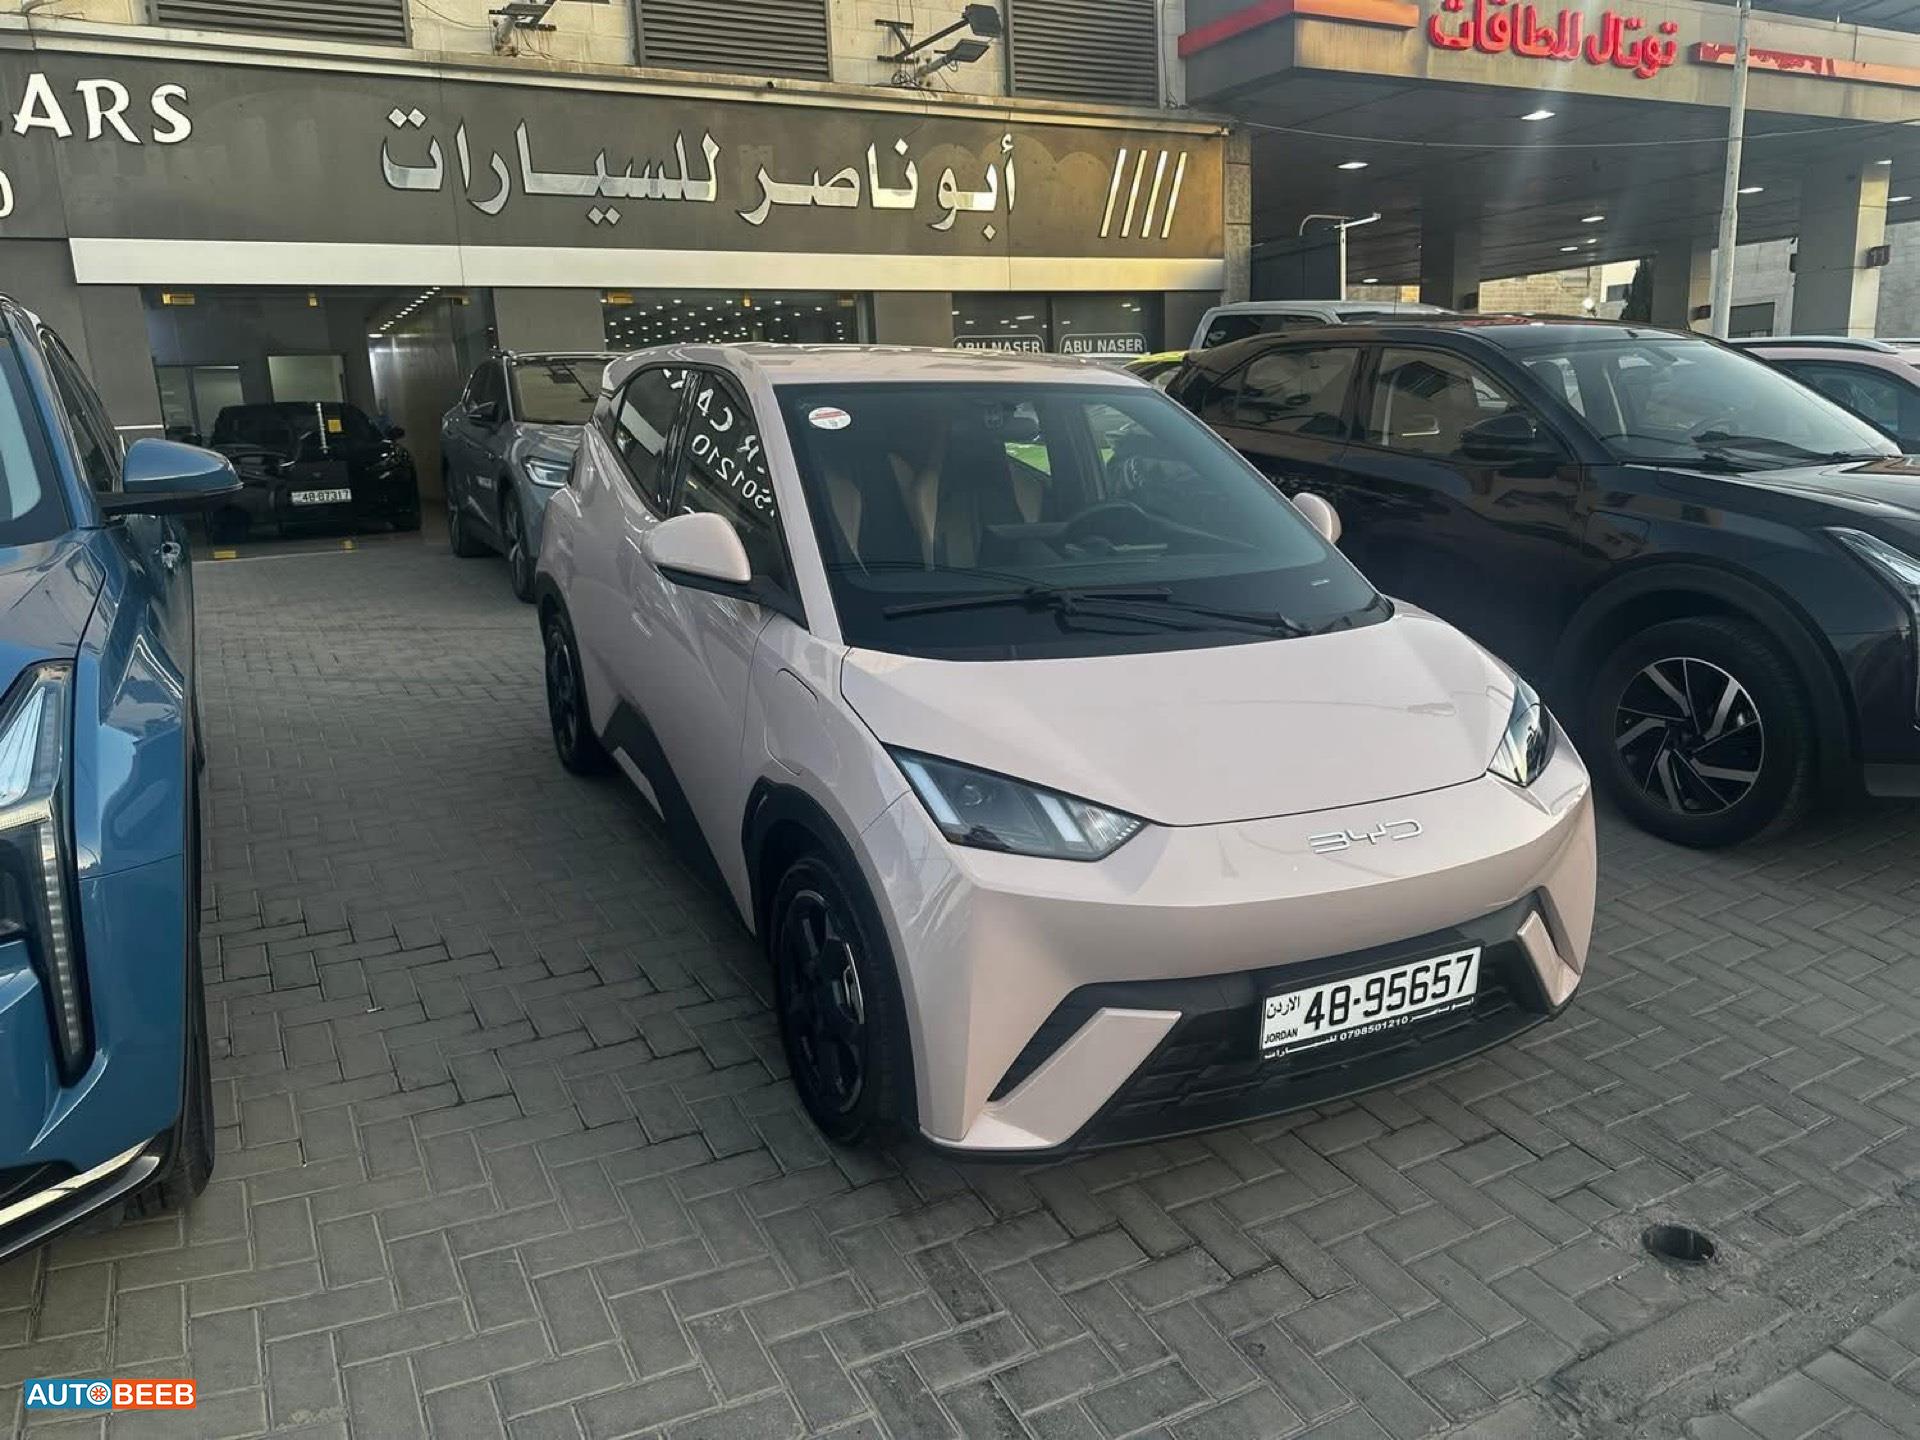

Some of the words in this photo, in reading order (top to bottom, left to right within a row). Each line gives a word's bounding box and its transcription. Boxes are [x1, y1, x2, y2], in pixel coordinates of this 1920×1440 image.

[11, 72, 192, 144] ARS
[382, 106, 721, 226] للسيارات
[737, 137, 919, 227] ناصر
[991, 341, 1040, 353] NASER
[1063, 340, 1092, 353] ABU
[1097, 338, 1143, 352] NASER
[1308, 818, 1423, 854] BYD
[1303, 953, 1474, 1031] 48-95657
[1264, 1027, 1299, 1044] JORDAN
[1339, 1014, 1409, 1042] 0798501210
